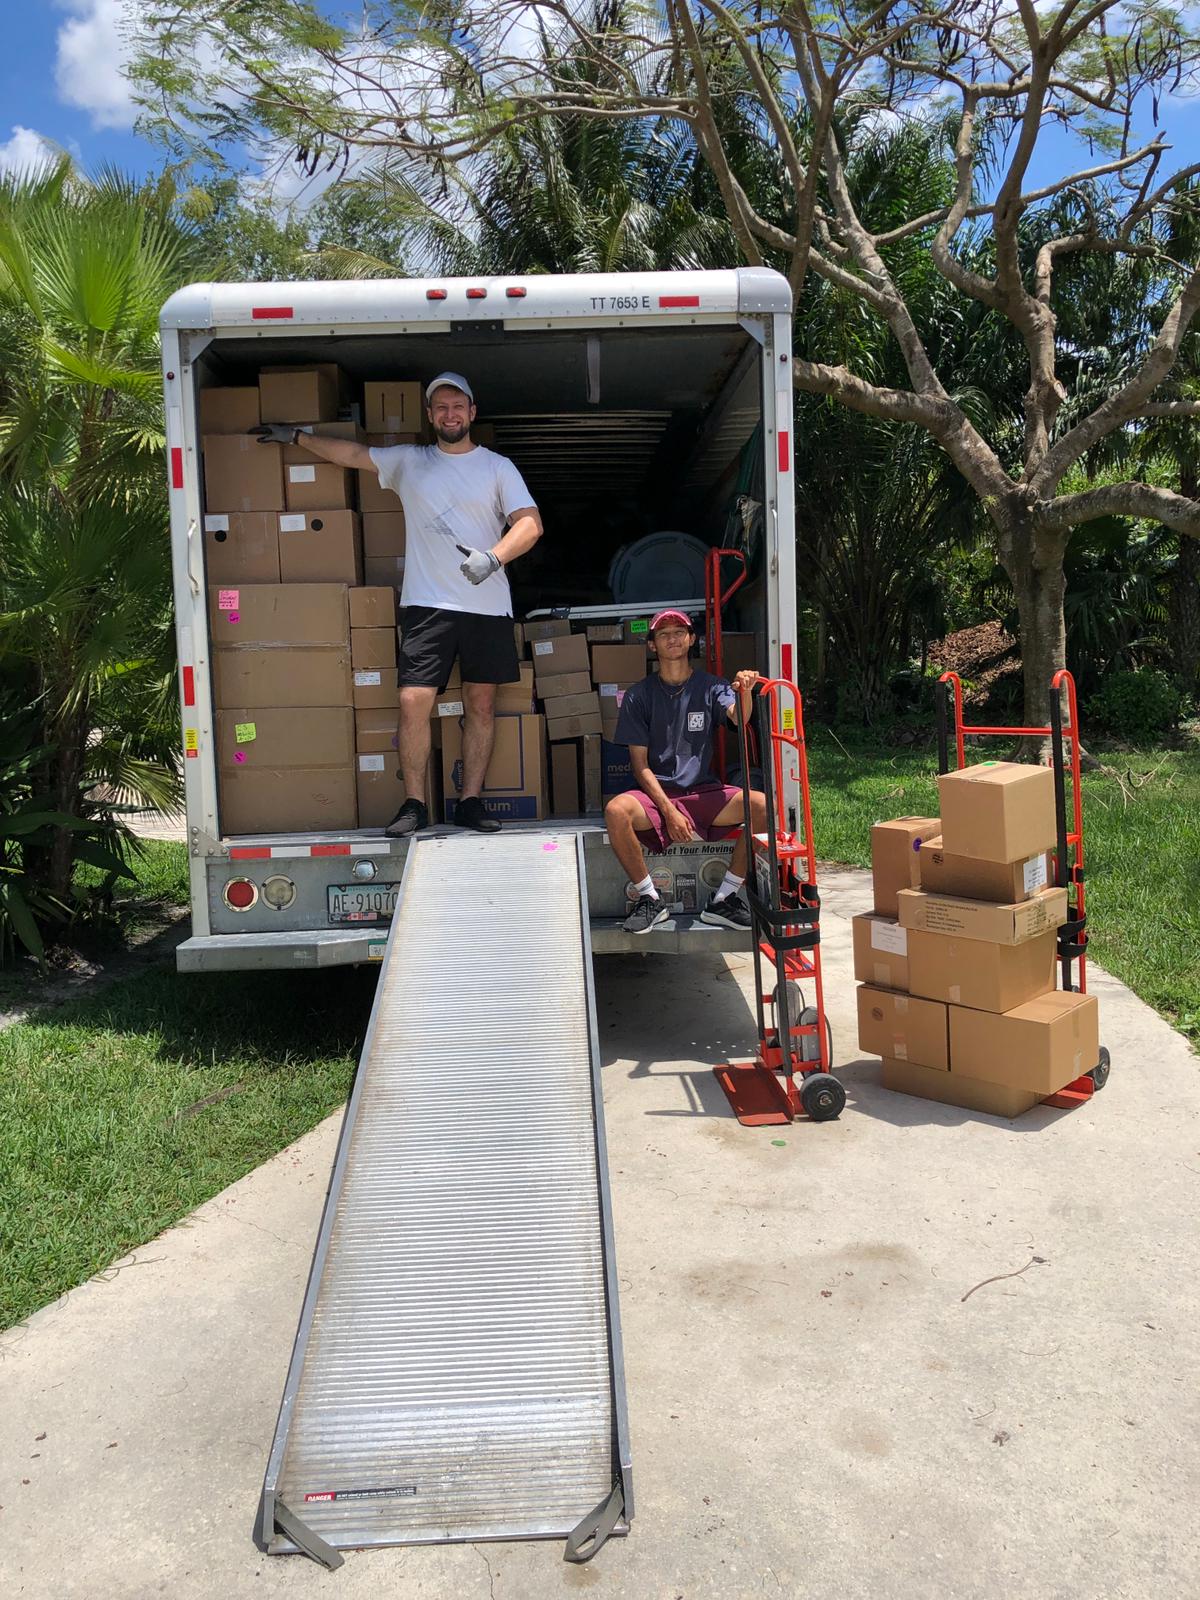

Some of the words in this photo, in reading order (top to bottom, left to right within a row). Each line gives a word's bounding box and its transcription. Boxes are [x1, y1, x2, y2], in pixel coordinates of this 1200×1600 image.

[590, 297, 606, 309] TT
[610, 296, 638, 309] 7653
[642, 296, 650, 308] E
[607, 762, 631, 772] med
[680, 846, 700, 855] Your
[702, 845, 735, 855] Moving
